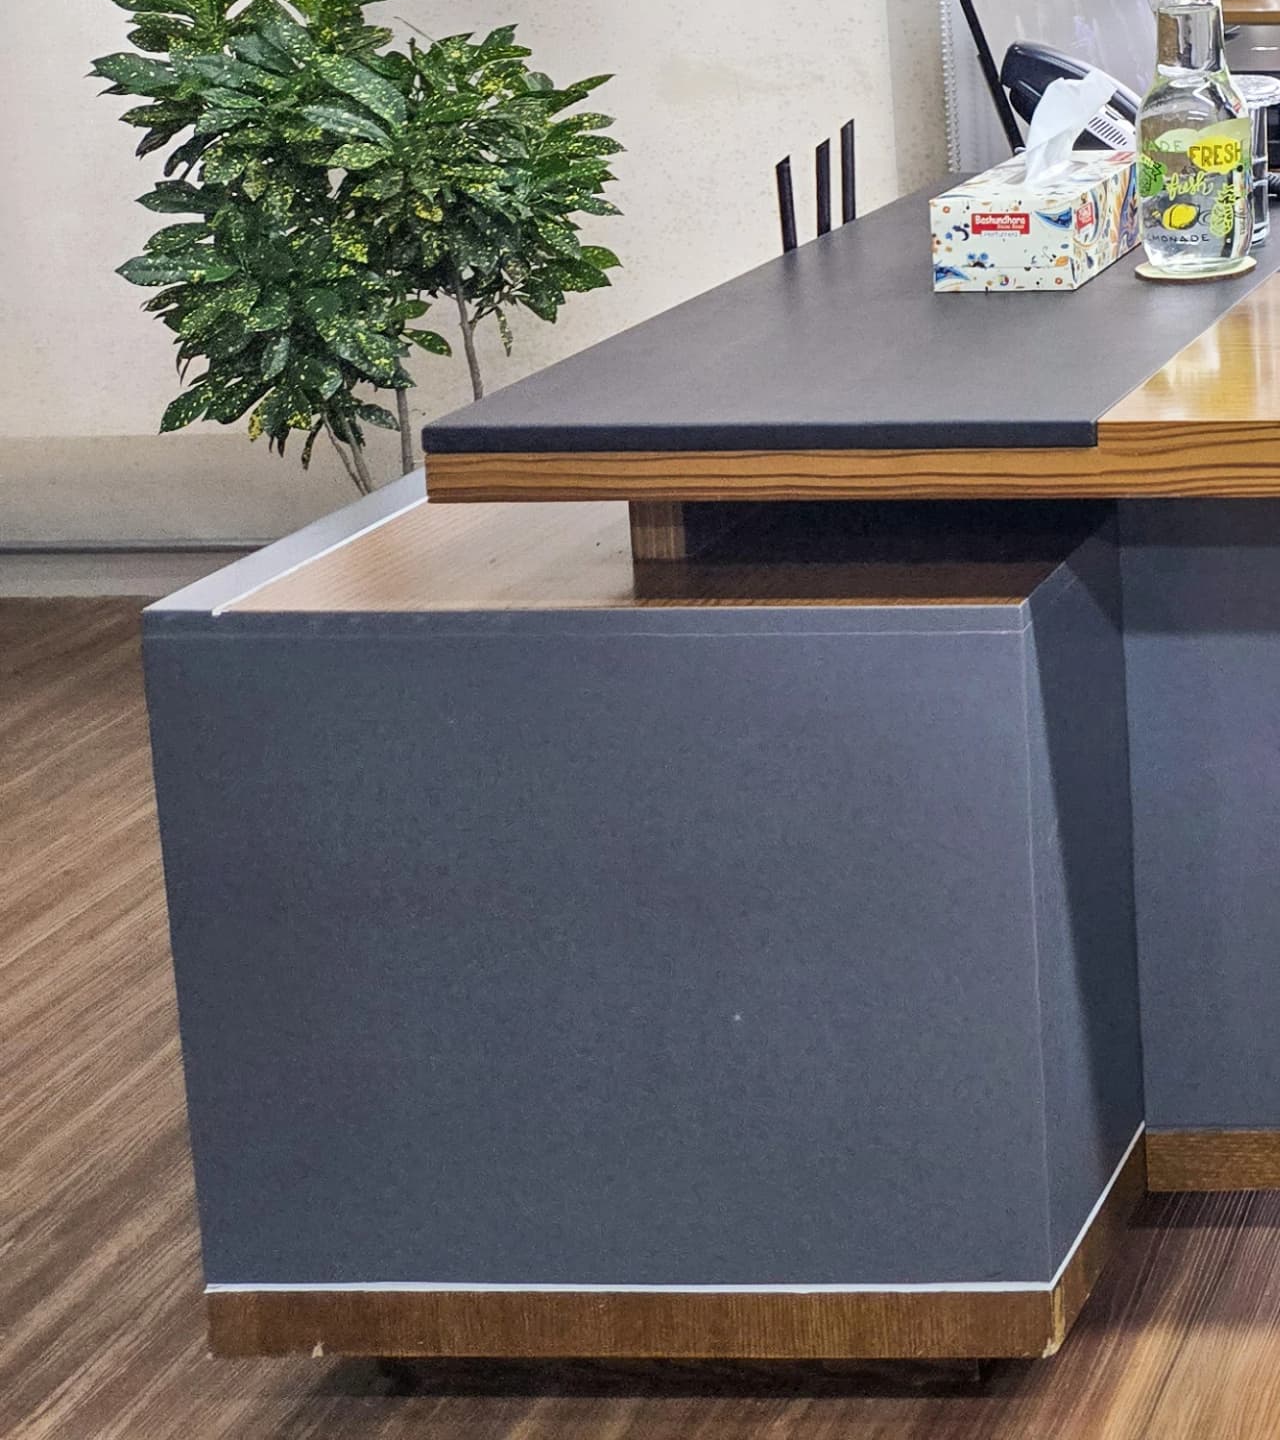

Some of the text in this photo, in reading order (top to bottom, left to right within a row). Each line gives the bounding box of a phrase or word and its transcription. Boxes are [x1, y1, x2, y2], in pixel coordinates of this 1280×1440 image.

[1188, 142, 1242, 167] FRESH
[1166, 171, 1214, 201] fresh
[975, 214, 1026, 225] Bashundhara
